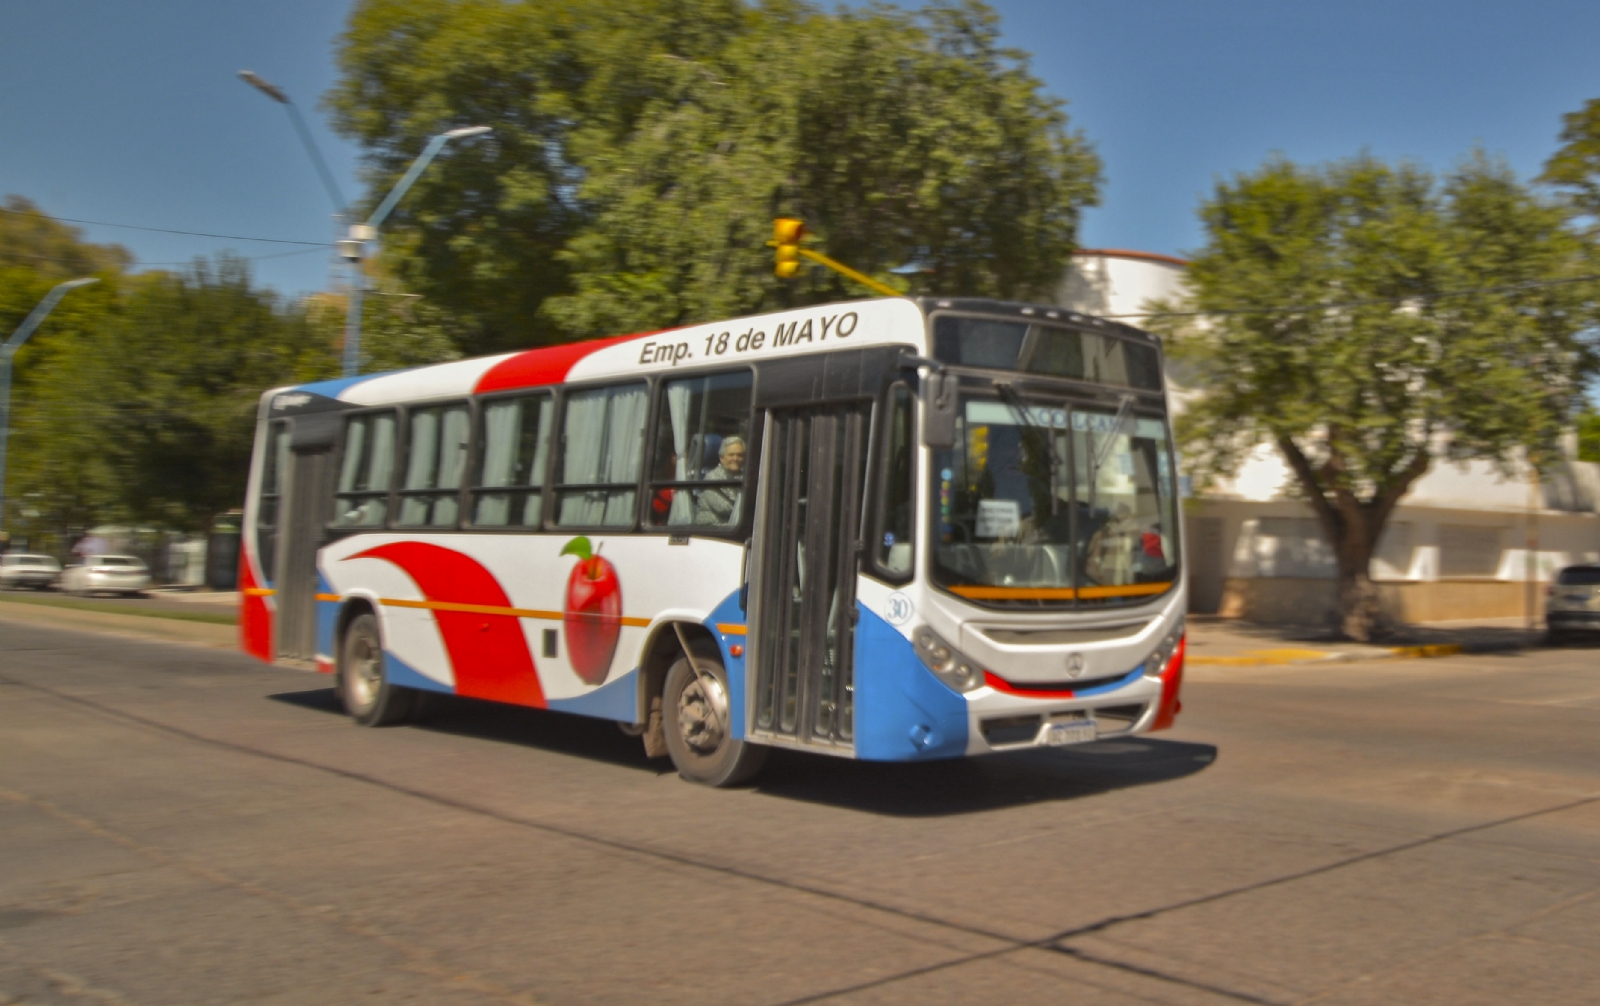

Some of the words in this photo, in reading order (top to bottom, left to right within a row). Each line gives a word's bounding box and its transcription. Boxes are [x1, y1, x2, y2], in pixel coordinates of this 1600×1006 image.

[639, 341, 693, 366] Emp.
[704, 331, 730, 356] 18
[735, 327, 765, 352] de
[772, 311, 858, 347] MAYO
[887, 598, 908, 620] 30
